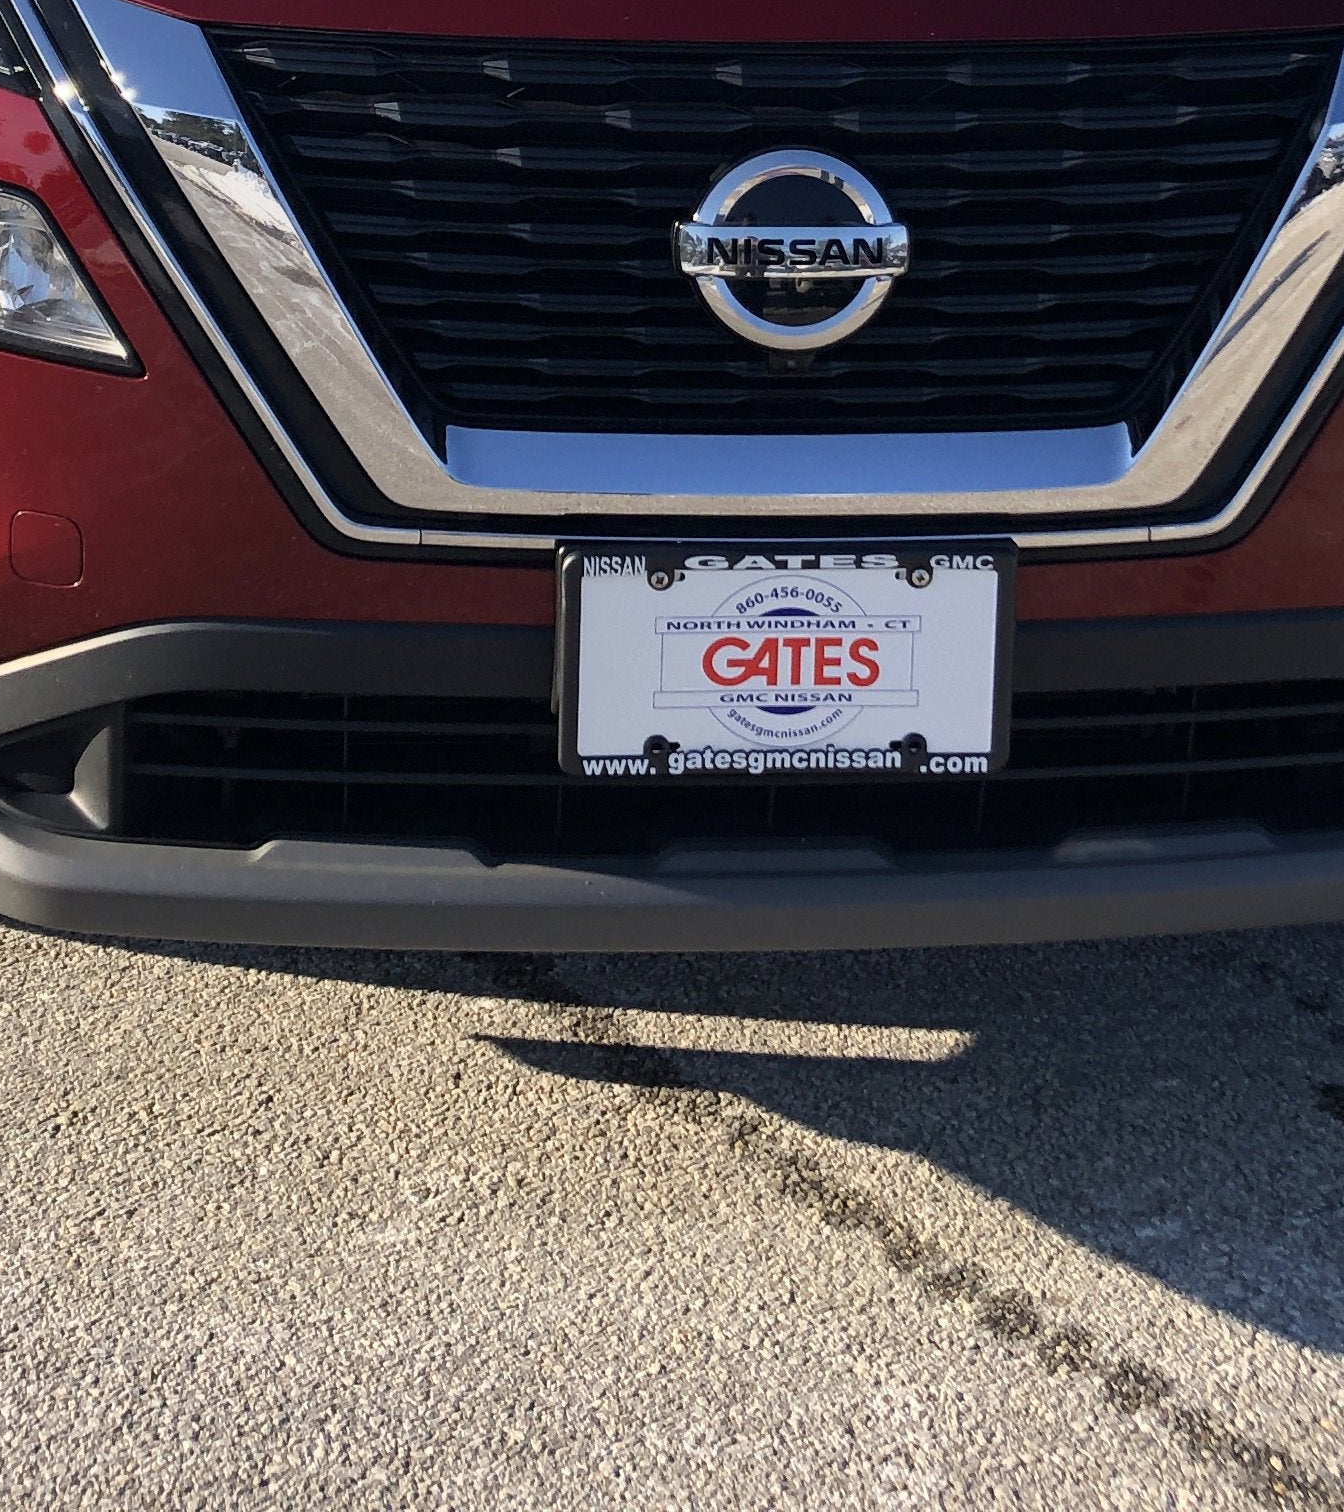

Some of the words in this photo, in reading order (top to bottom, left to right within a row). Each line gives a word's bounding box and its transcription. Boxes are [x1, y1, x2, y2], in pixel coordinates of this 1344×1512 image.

[705, 237, 884, 267] NISSAN
[583, 554, 647, 578] NISSAN
[683, 554, 900, 570] GATES
[929, 554, 995, 570] GMC
[735, 586, 844, 615] 860-456-0055
[666, 620, 742, 631] NORTH
[746, 619, 857, 630] WINDHAM
[883, 619, 912, 630] CT
[702, 636, 881, 687] GATES
[719, 692, 766, 703] GMC
[774, 691, 853, 703] NISSAN
[726, 707, 844, 739] gatesgmcnissan.com
[582, 757, 657, 776] www.
[668, 745, 902, 775] gatesgmcnissan
[919, 754, 989, 774] .com
